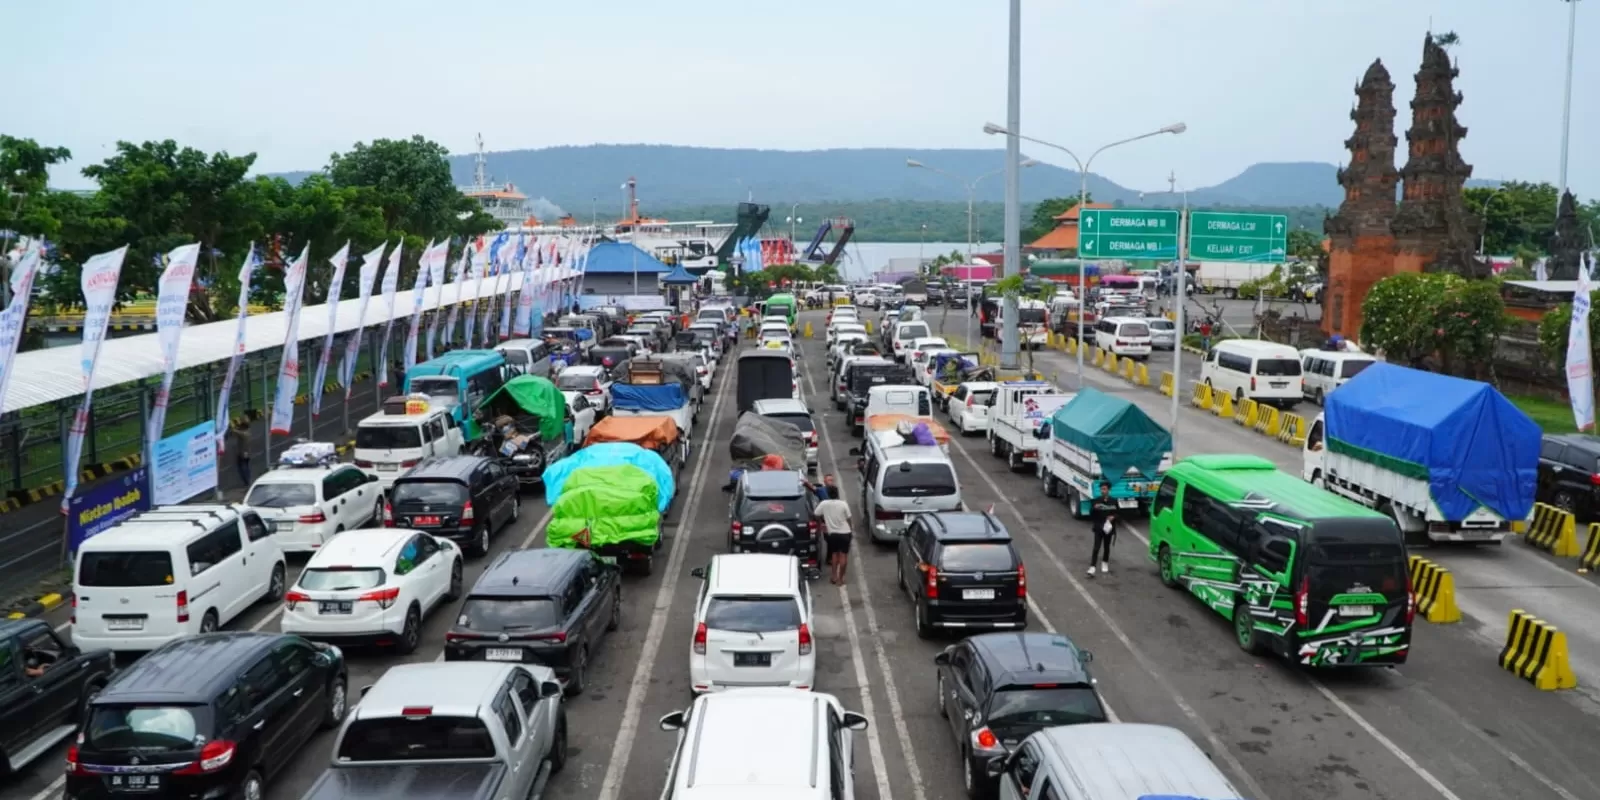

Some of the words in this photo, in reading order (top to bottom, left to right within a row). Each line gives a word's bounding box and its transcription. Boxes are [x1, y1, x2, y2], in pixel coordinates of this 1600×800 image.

[1110, 216, 1146, 227] DERMAGA
[1147, 218, 1159, 228] MB
[1207, 220, 1240, 231] DERMAGA
[1241, 221, 1257, 231] LCM
[1109, 241, 1145, 251] DERMAGA
[1206, 244, 1234, 254] KELUAR
[1238, 245, 1253, 255] EXIT
[79, 503, 112, 526] Niatkan
